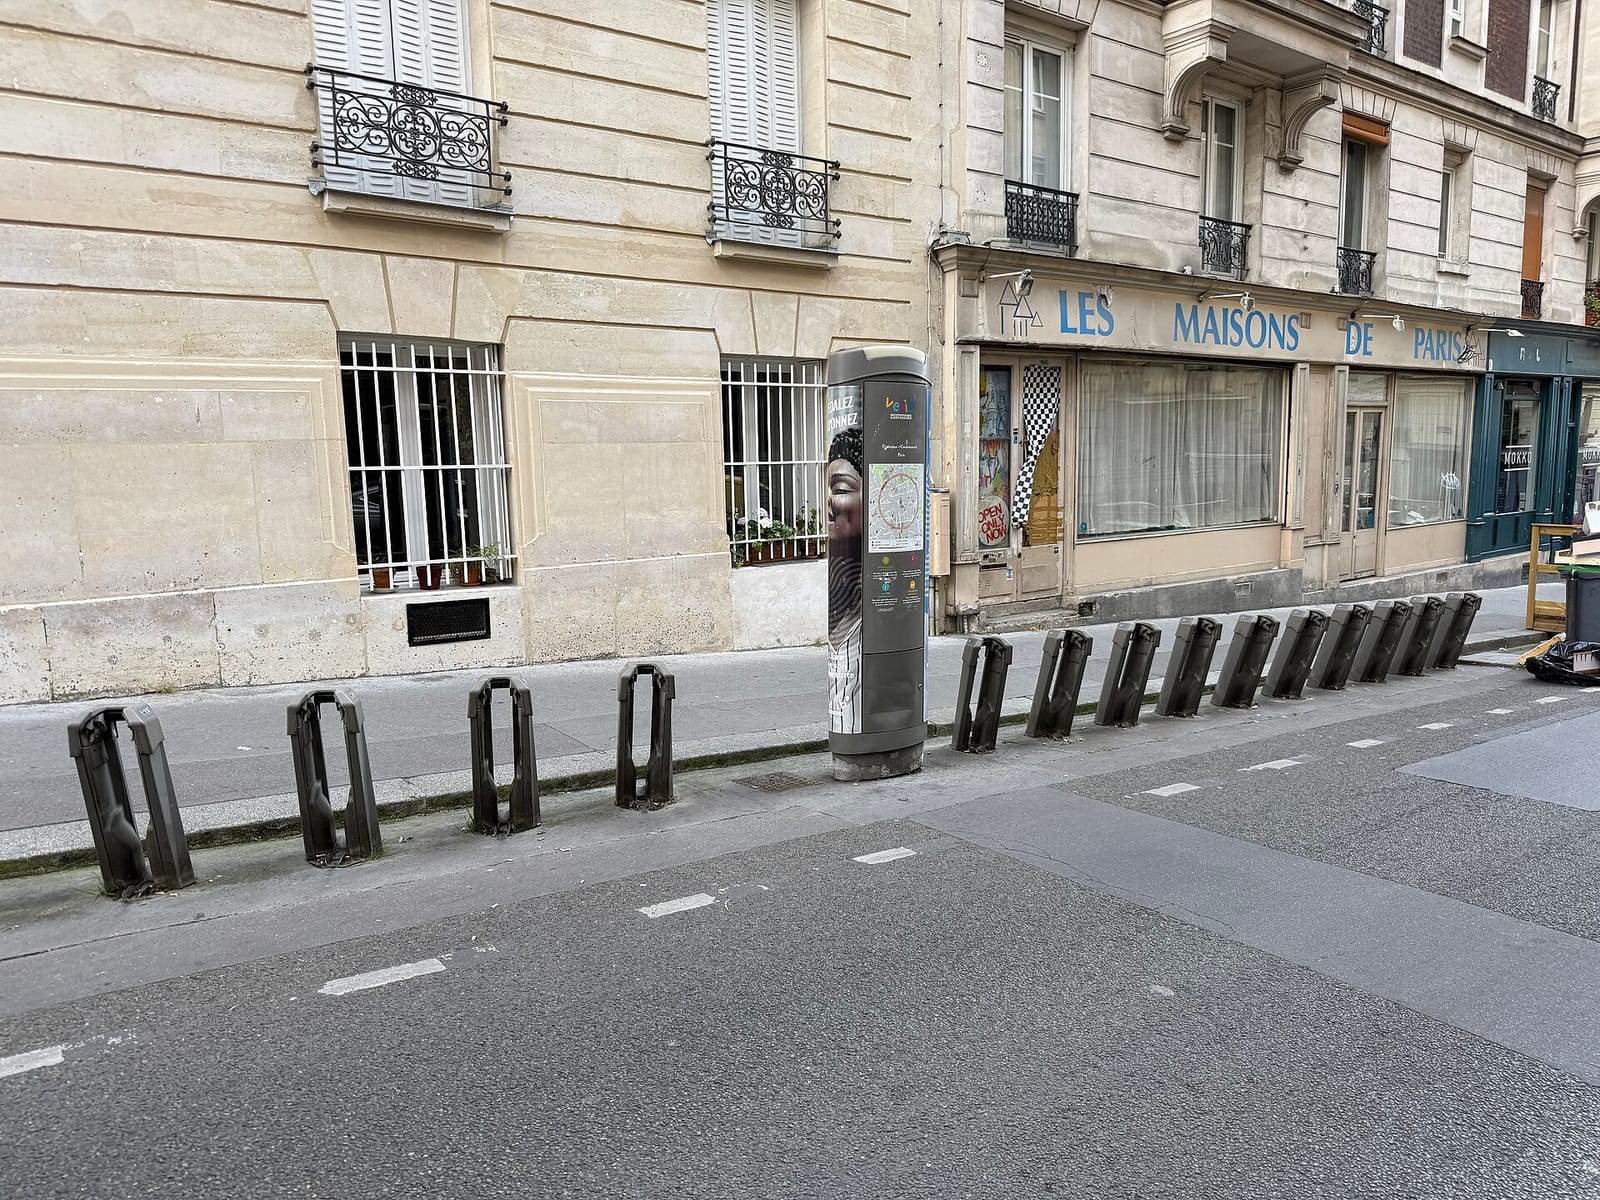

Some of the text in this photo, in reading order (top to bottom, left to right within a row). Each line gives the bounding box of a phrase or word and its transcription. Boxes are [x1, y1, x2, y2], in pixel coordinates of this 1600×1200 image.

[1058, 290, 1462, 361] LES MAISONS DE PARIS
[1504, 451, 1533, 465] MOKKO
[978, 503, 1003, 523] OPEN
[981, 513, 1005, 533] ONLY
[986, 524, 1007, 544] NOW
